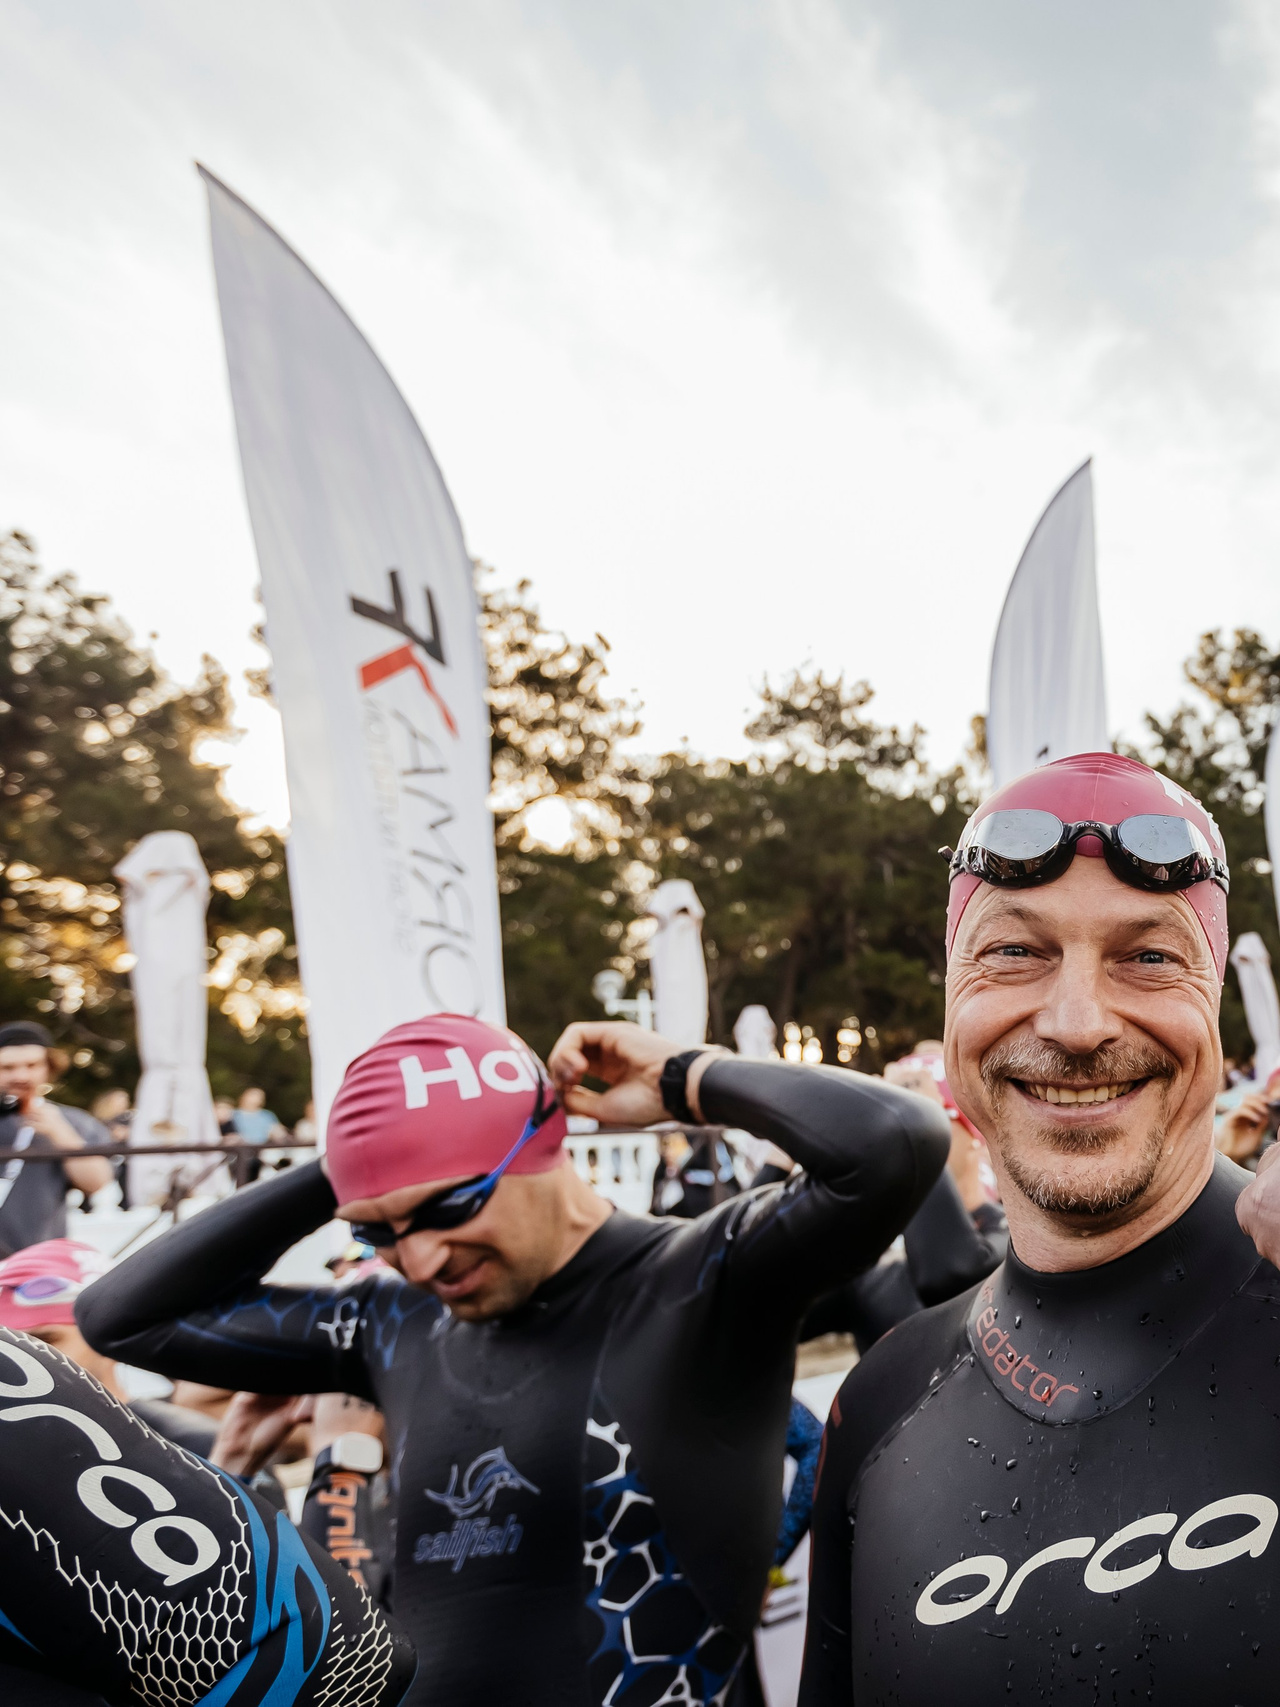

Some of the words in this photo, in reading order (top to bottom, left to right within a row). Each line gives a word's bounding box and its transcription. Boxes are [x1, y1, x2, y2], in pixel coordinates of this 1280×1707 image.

[0, 1337, 220, 1586] orca
[412, 1513, 524, 1573] sailfish
[916, 1493, 1279, 1625] orca
